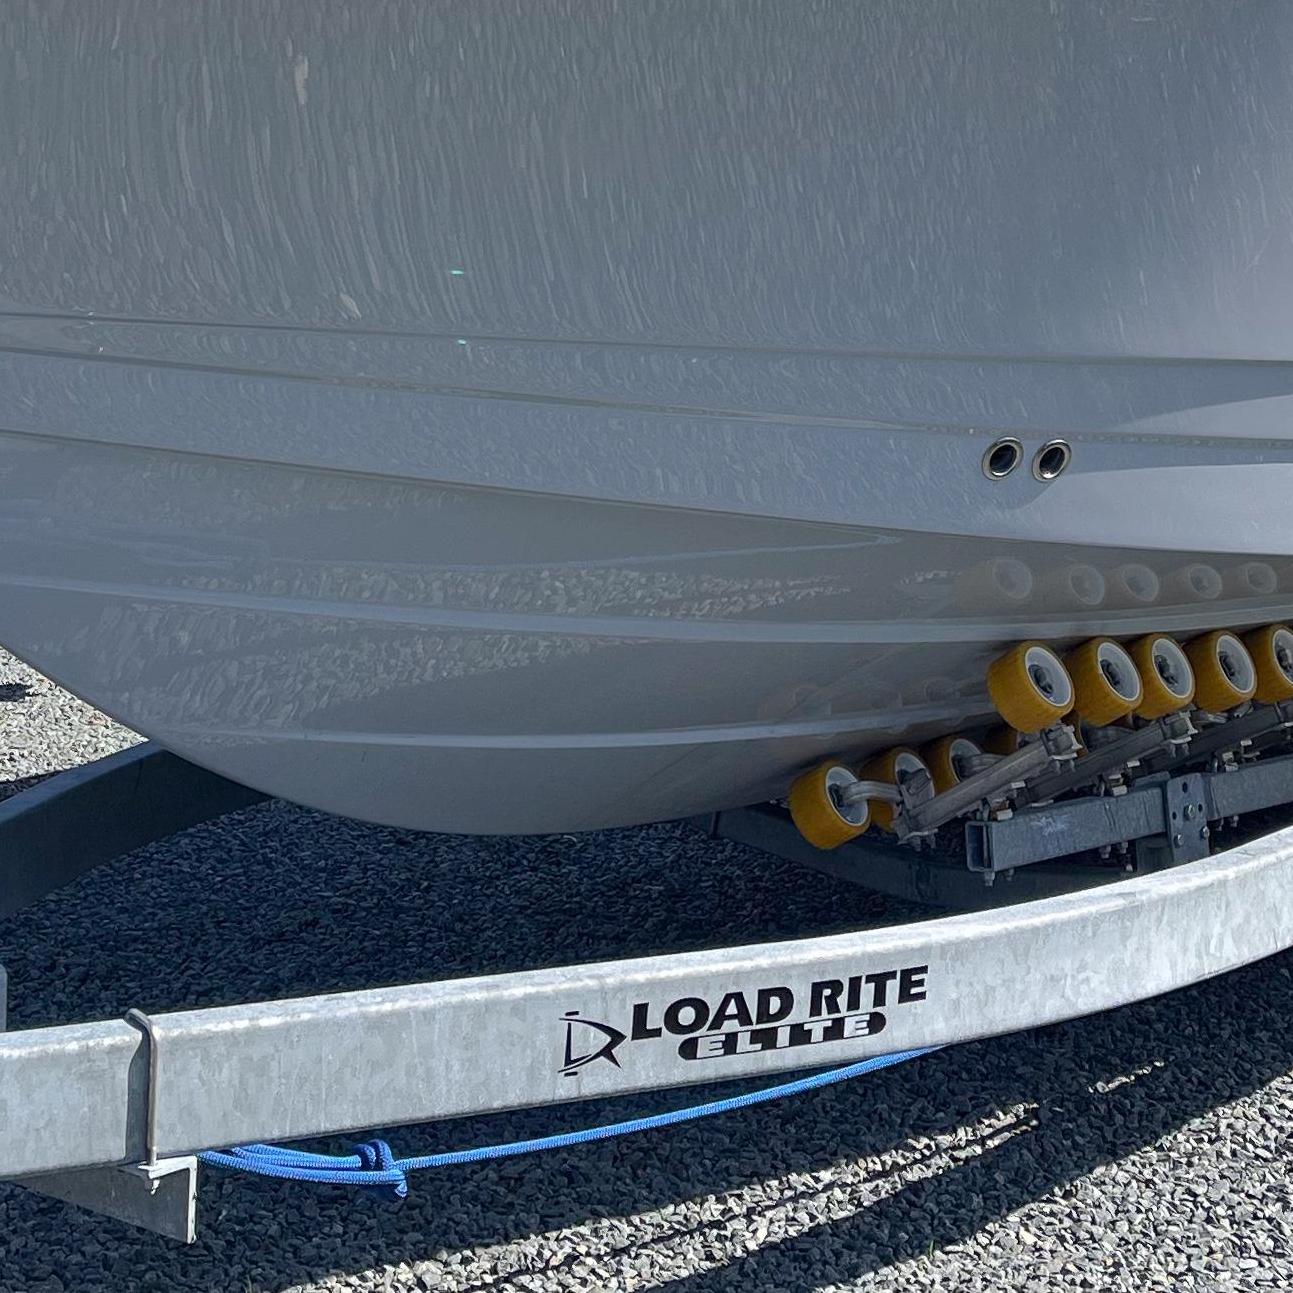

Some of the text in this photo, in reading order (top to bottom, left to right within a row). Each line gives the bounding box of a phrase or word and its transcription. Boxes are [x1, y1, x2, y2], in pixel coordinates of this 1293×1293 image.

[631, 965, 929, 1041] LOAD RITE
[695, 1013, 872, 1059] ELITE
